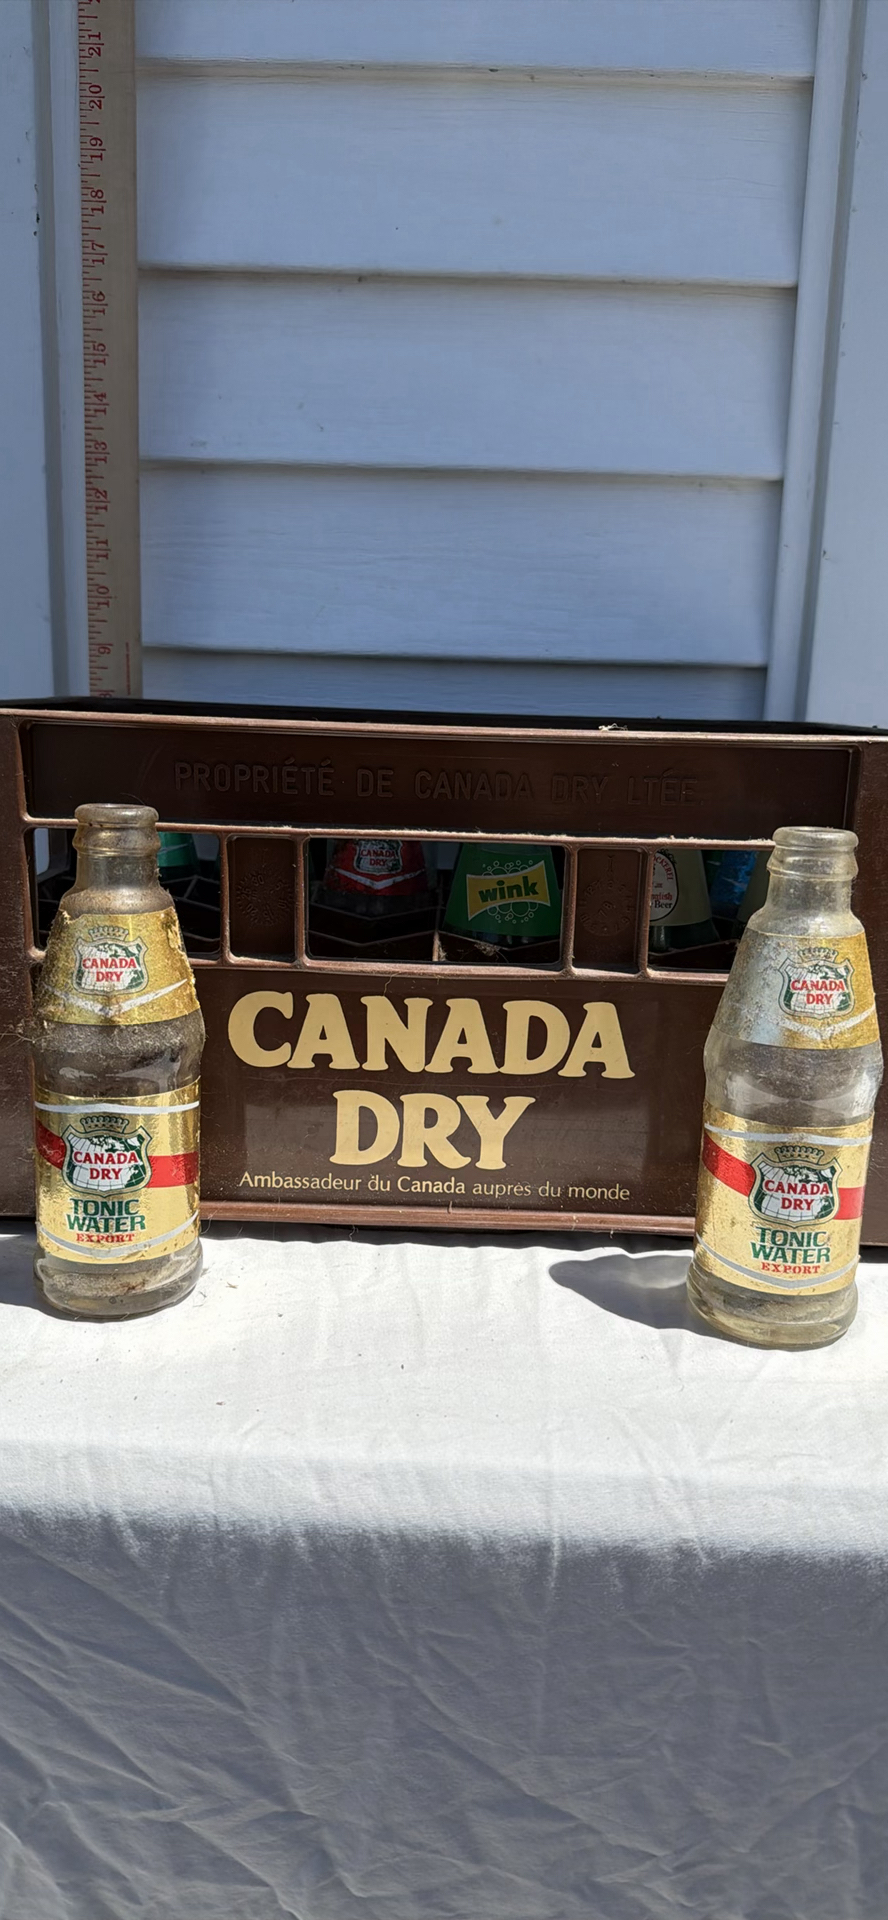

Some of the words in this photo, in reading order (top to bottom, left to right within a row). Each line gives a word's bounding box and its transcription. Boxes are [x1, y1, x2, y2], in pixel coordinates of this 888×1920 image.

[88, 32, 101, 57] 21
[89, 84, 102, 110] 20
[89, 137, 103, 161] 19
[90, 189, 104, 214] 18
[91, 242, 105, 265] 17
[92, 291, 106, 316] 16
[93, 342, 106, 366] 15
[93, 392, 107, 415] 14
[94, 441, 108, 464] 13
[95, 489, 108, 513] 12
[96, 539, 109, 560] 11
[96, 585, 110, 609] 10
[98, 646, 111, 655] 9
[174, 757, 335, 796] PROPRIÉTÉ
[356, 768, 395, 798] DE
[414, 769, 534, 802] CANADA
[551, 773, 609, 804] DRY
[360, 849, 397, 859] CANADA
[369, 858, 388, 867] DRY
[478, 876, 539, 903] wink
[654, 900, 673, 909] Beer
[82, 957, 137, 969] CANADA
[95, 971, 124, 982] DRY
[790, 979, 845, 992] CANADA
[806, 993, 833, 1005] DRY
[227, 990, 636, 1079] CANADA
[328, 1089, 537, 1170] DRY
[73, 1151, 139, 1165] CANADA
[89, 1168, 123, 1181] DRY
[239, 1170, 362, 1191] Ambassadeur
[367, 1174, 391, 1191] du
[397, 1176, 466, 1194] Canada
[538, 1181, 561, 1197] du
[568, 1183, 630, 1200] monde
[764, 1180, 830, 1196] CANADA
[69, 1198, 140, 1217] TONIC
[781, 1197, 815, 1211] DRY
[66, 1214, 147, 1233] WATER
[76, 1233, 136, 1243] EXPORT
[755, 1226, 827, 1247] TONIC
[750, 1242, 831, 1264] WATER
[761, 1262, 821, 1275] EXPORT
